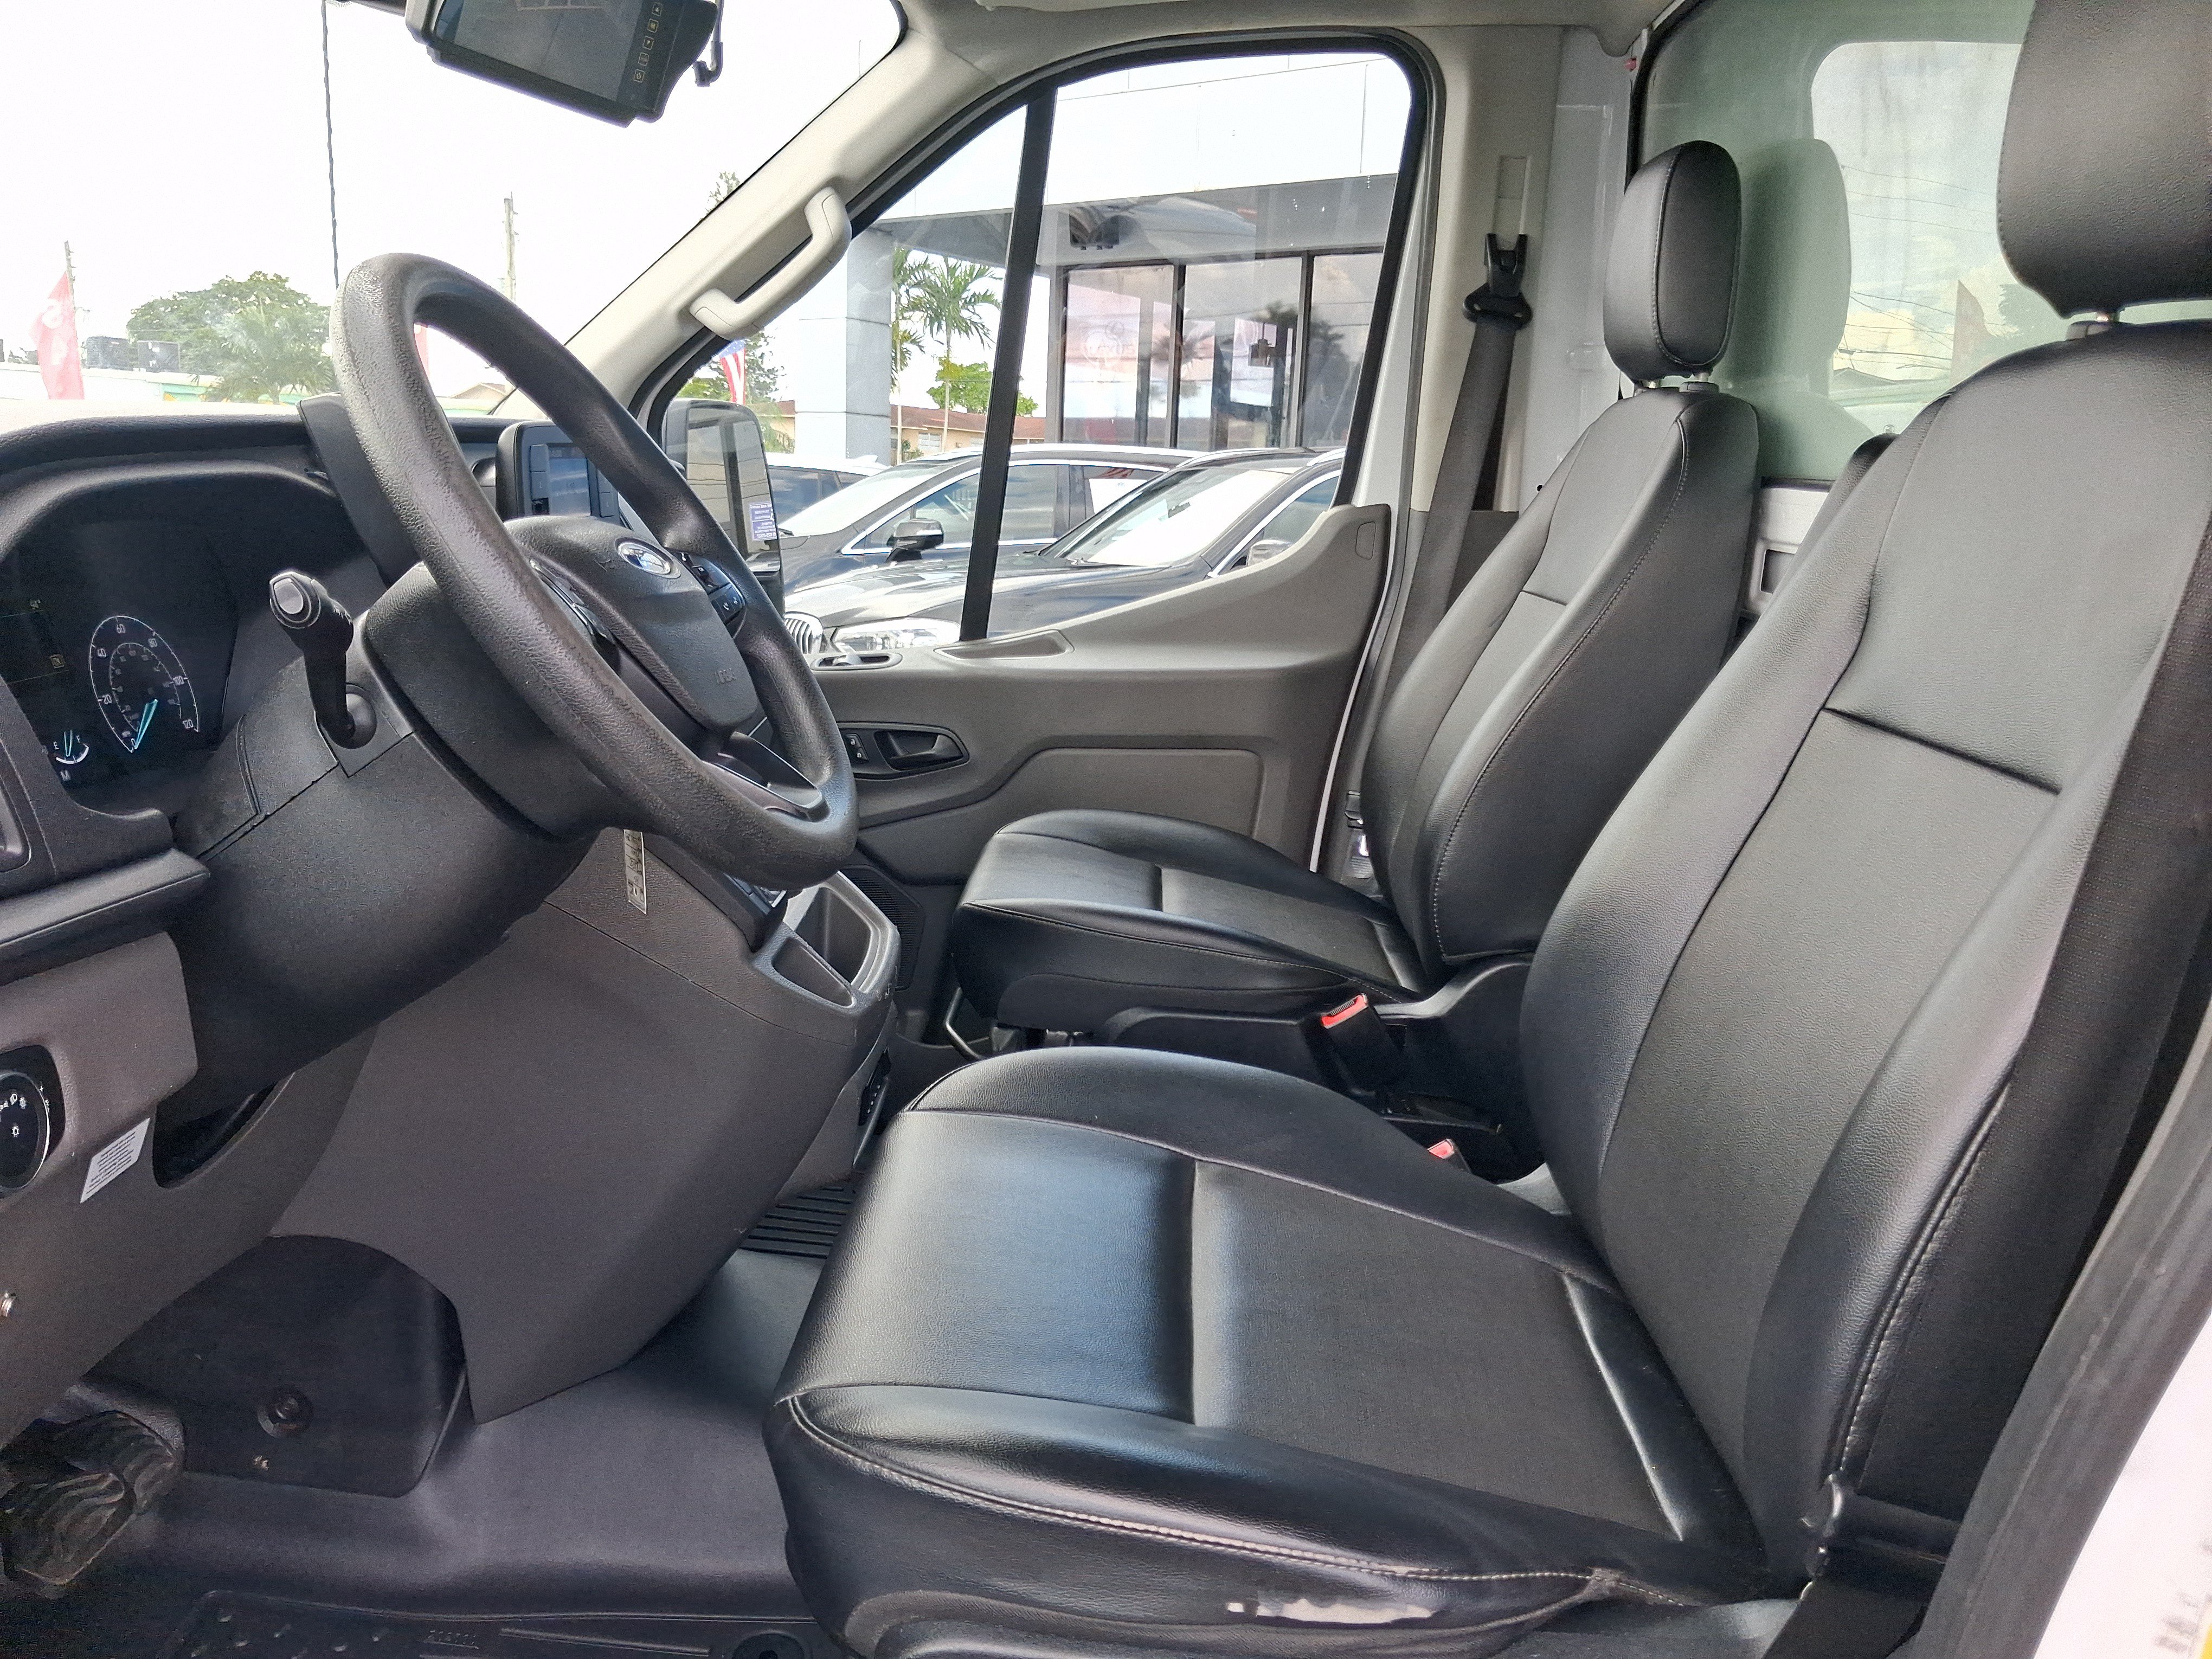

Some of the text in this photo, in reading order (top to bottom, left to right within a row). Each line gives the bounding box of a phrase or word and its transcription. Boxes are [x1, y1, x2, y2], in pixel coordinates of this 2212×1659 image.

[173, 676, 185, 685] 100
[102, 694, 112, 704] 20
[182, 719, 194, 729] 120
[76, 735, 80, 743] F
[53, 741, 60, 750] E
